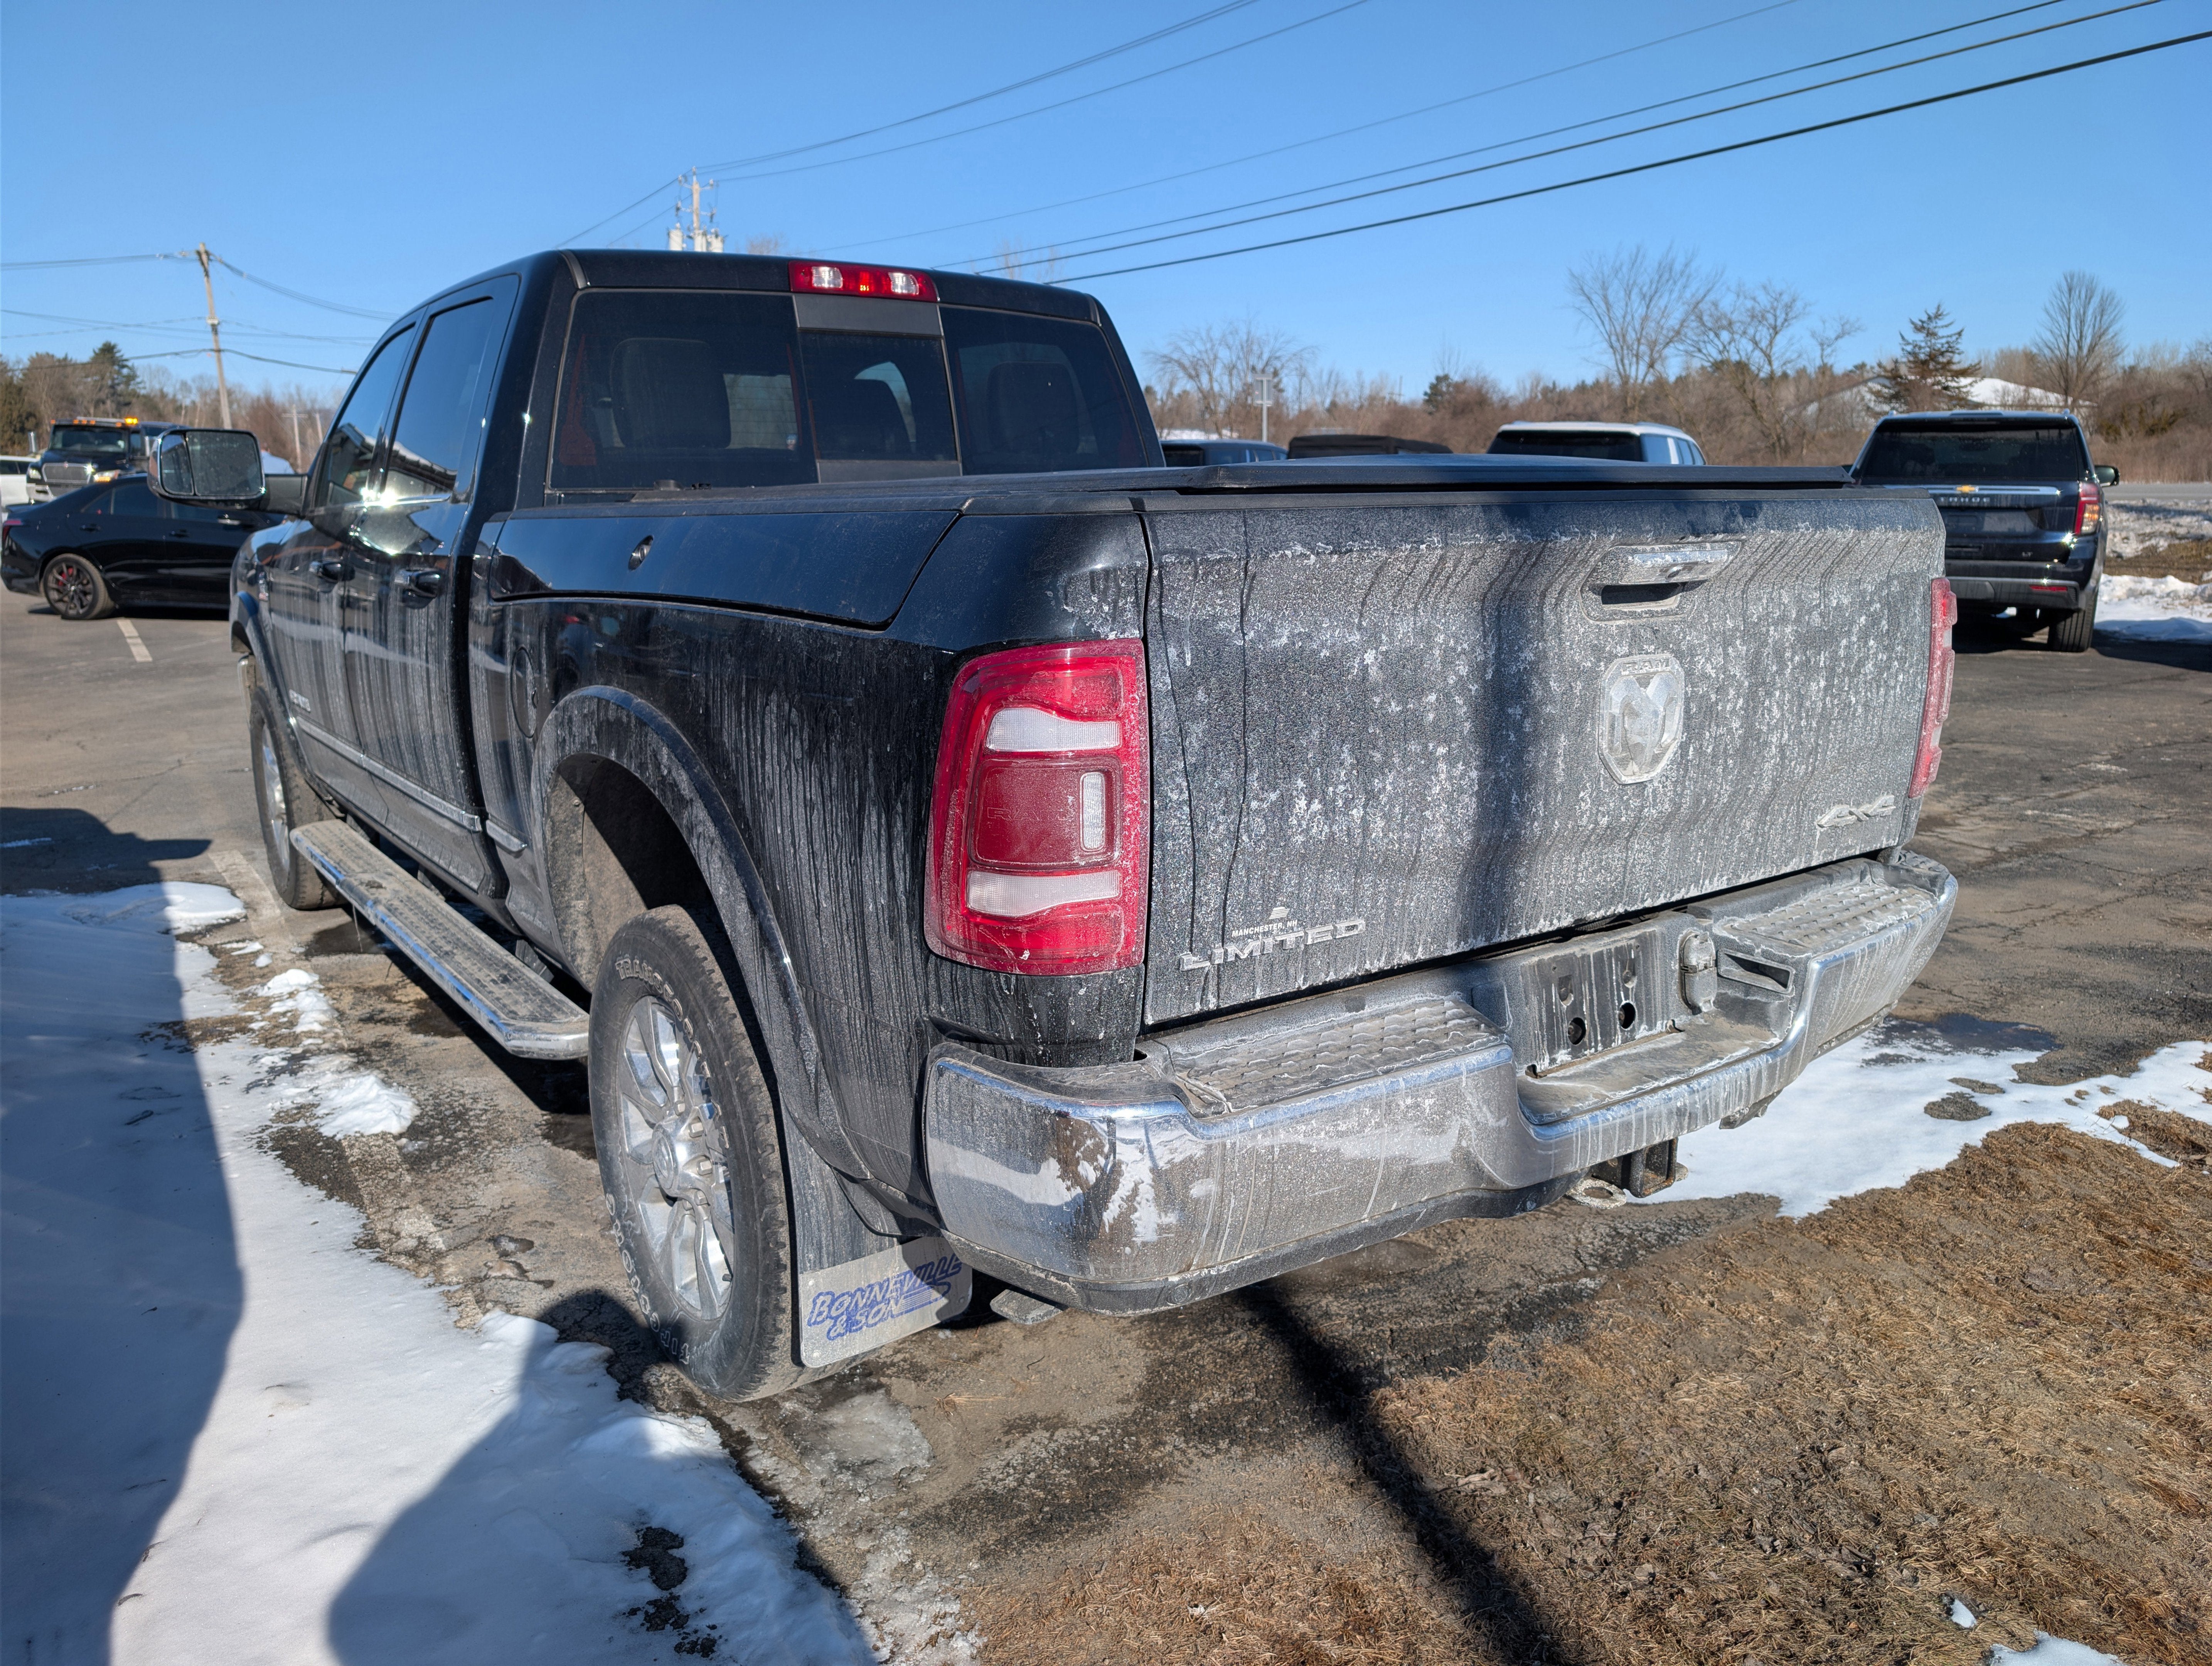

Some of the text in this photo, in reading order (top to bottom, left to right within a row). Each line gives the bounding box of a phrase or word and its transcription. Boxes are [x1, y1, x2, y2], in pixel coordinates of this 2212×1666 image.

[1622, 658, 1670, 672] RAM
[987, 807, 1068, 821] RAM
[1232, 919, 1297, 937] MANCHESTER, NH
[1179, 918, 1366, 971] LIMITED
[808, 1253, 962, 1327] BONNEVILLE
[826, 1294, 905, 1341] & SON
